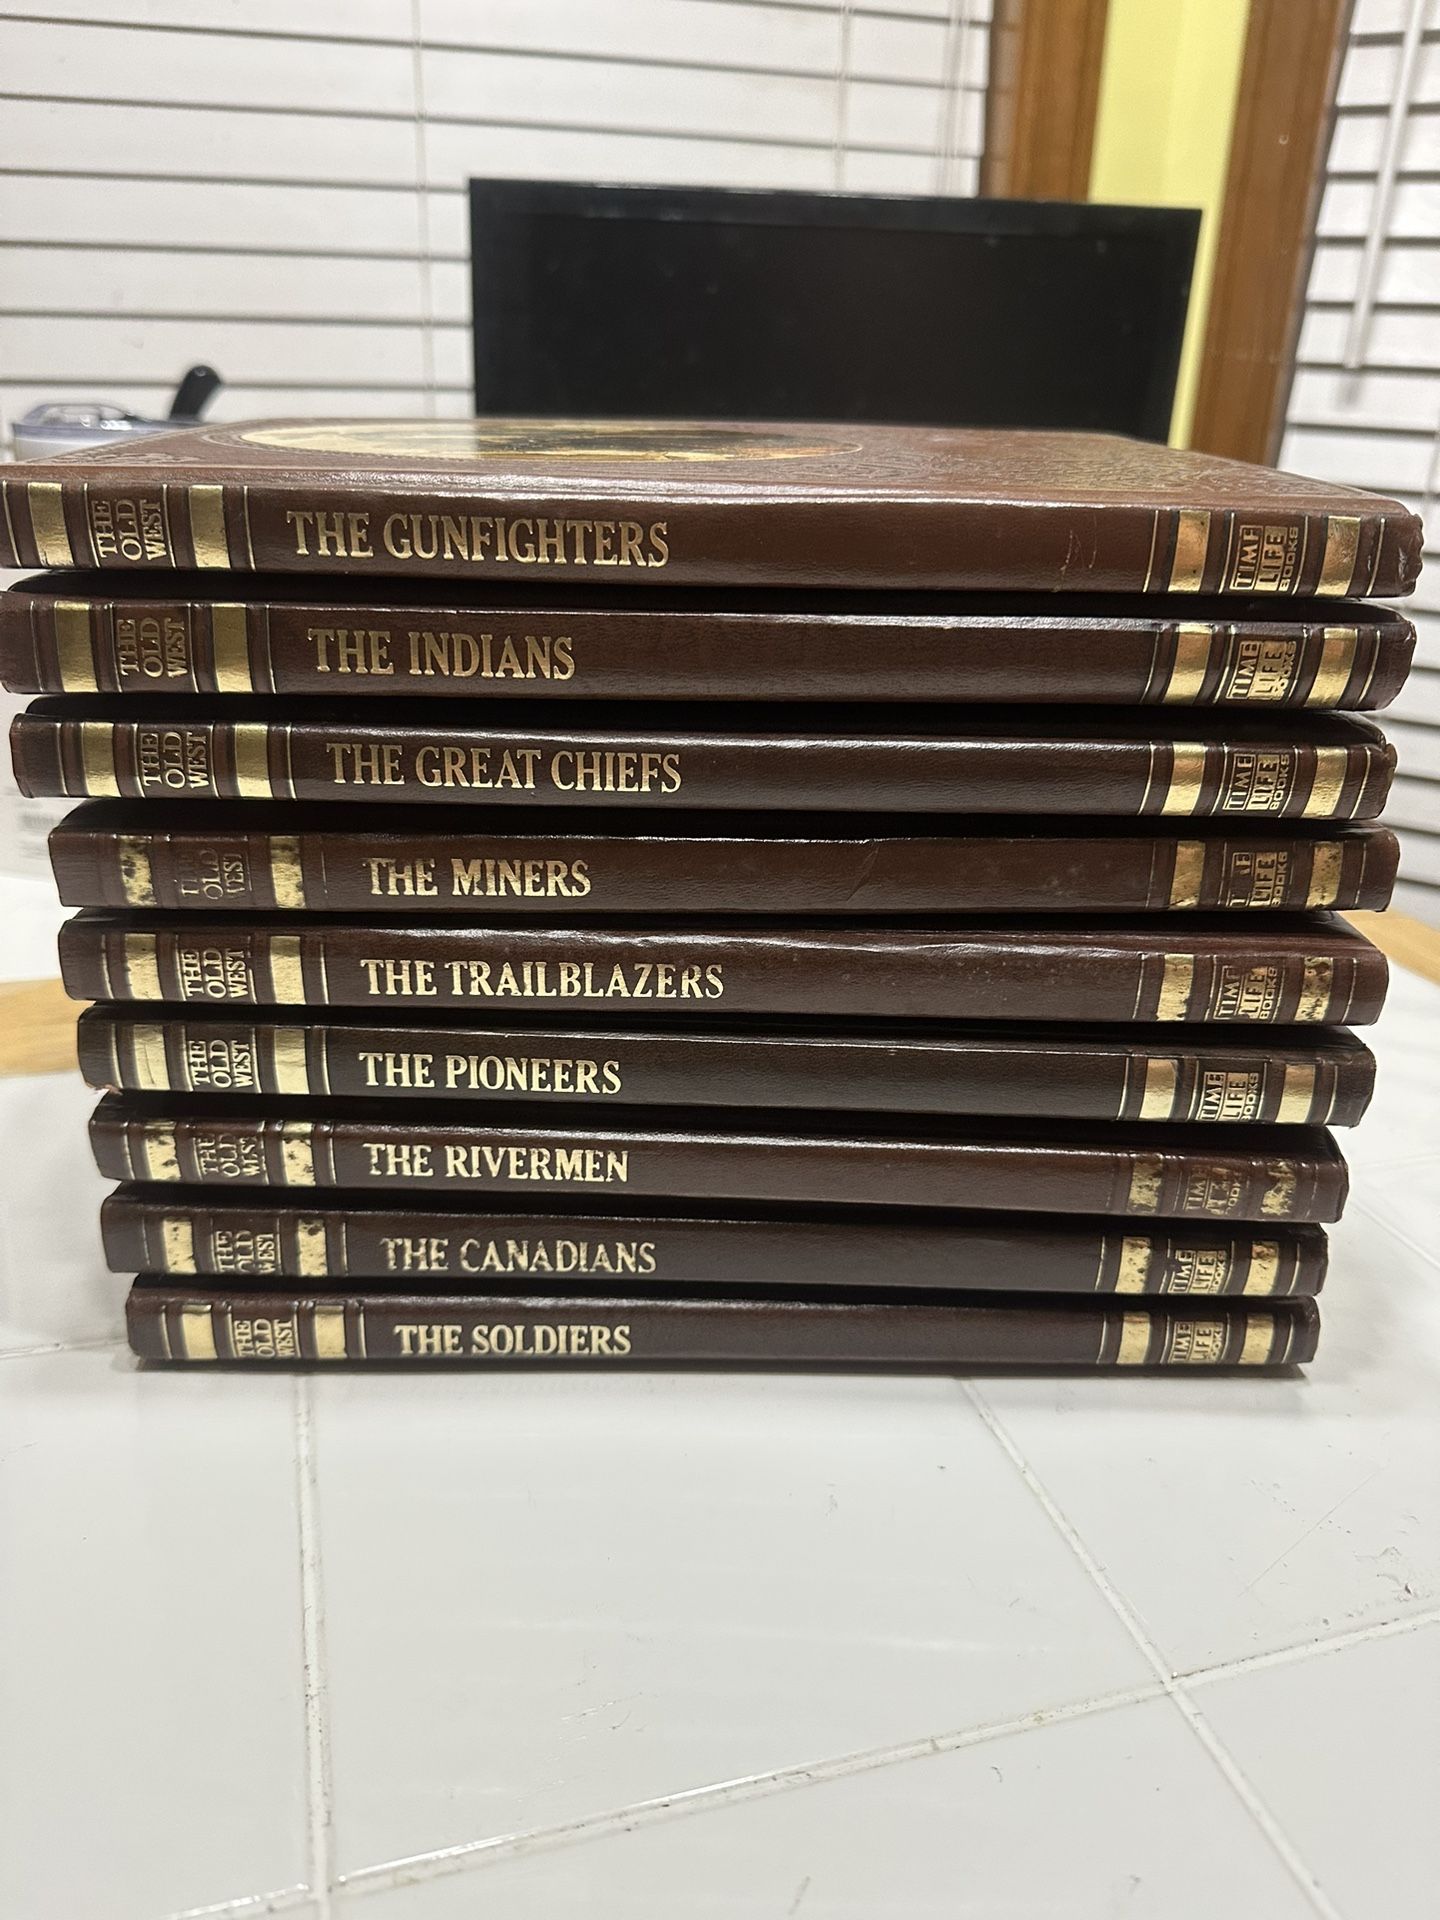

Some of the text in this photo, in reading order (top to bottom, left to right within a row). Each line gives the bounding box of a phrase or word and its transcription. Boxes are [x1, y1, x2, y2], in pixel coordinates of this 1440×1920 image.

[91, 499, 117, 557] THE
[116, 499, 141, 560] OLD
[139, 499, 167, 560] WEST
[286, 511, 669, 568] THE GUNFIGHTERS
[1256, 526, 1283, 590] LIFE
[1280, 527, 1298, 591] BOOKS
[118, 619, 139, 676] THE
[139, 617, 162, 678] OLD
[162, 618, 188, 678] WEST
[308, 628, 575, 680] THE INDIANS
[1231, 642, 1260, 698] TIME
[1253, 641, 1285, 699] LIFE
[139, 733, 160, 787] THE
[161, 731, 183, 788] OLD
[183, 732, 209, 788] WEST
[327, 743, 681, 793] THE GREAT CHIEFS
[1226, 755, 1254, 809] TIME
[1251, 755, 1278, 809] LIFE
[1269, 756, 1289, 809] BOOKS
[362, 857, 591, 897] THE MINERS
[1252, 852, 1277, 907] LIFE
[1272, 852, 1288, 907] BOOKS
[180, 948, 204, 998] THE
[204, 947, 226, 999] OLD
[226, 947, 250, 999] WEST
[360, 959, 724, 998] THE TRAILBLAZERS
[1240, 967, 1266, 1018] LIFE
[1259, 966, 1277, 1020] BOOKS
[188, 1040, 210, 1086] THE
[210, 1039, 232, 1088] OLD
[232, 1040, 255, 1089] WEST
[359, 1052, 622, 1094] THE PIONEERS
[1201, 1072, 1224, 1120] TIME
[1223, 1072, 1248, 1120] LIFE
[363, 1143, 628, 1182] THE RIVERMEN
[214, 1230, 236, 1273] THE
[381, 1237, 656, 1273] THE CANADIANS
[1171, 1251, 1195, 1292] TIME
[1193, 1251, 1216, 1294] LIFE
[231, 1321, 252, 1356] THE
[253, 1319, 274, 1358] OLD
[274, 1320, 295, 1358] WEST
[394, 1325, 631, 1355] THE SOLDIERS
